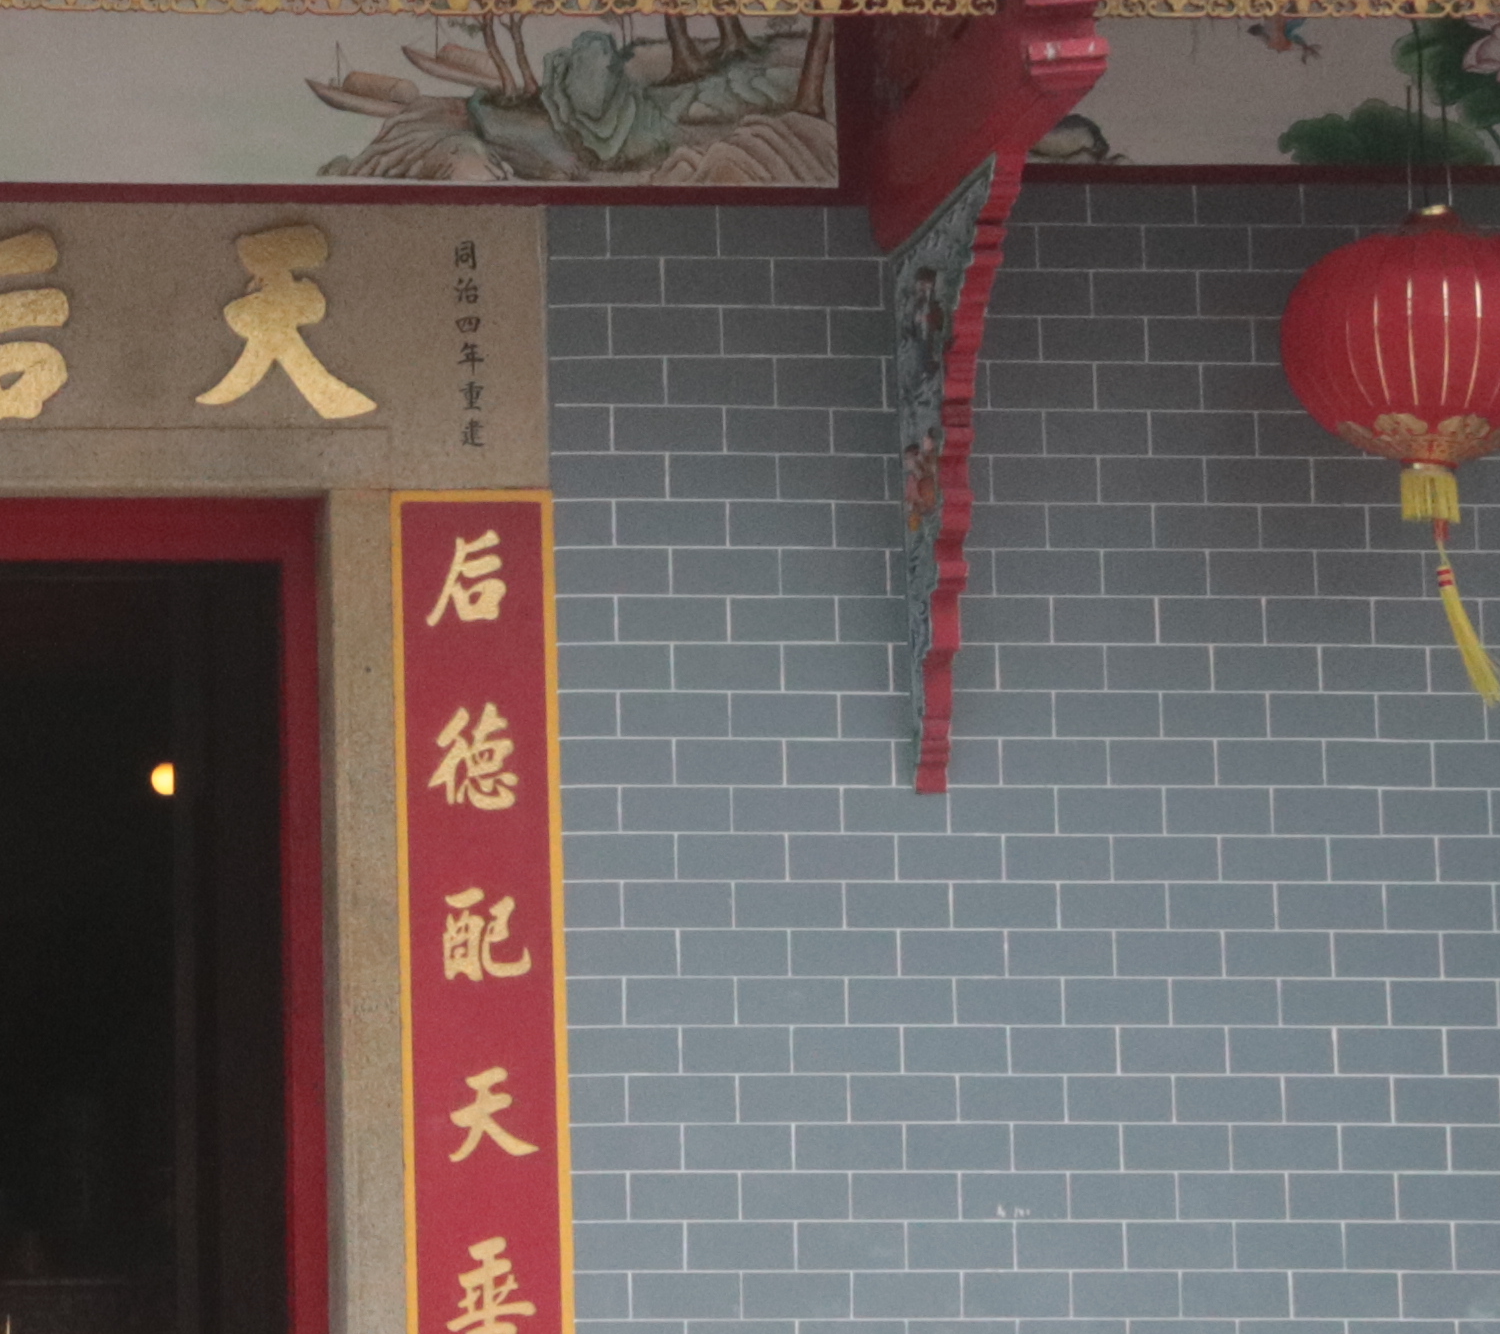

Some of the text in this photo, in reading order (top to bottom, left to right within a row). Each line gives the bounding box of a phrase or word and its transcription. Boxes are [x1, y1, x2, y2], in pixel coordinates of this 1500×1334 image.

[454, 240, 484, 447] 同治四年重建
